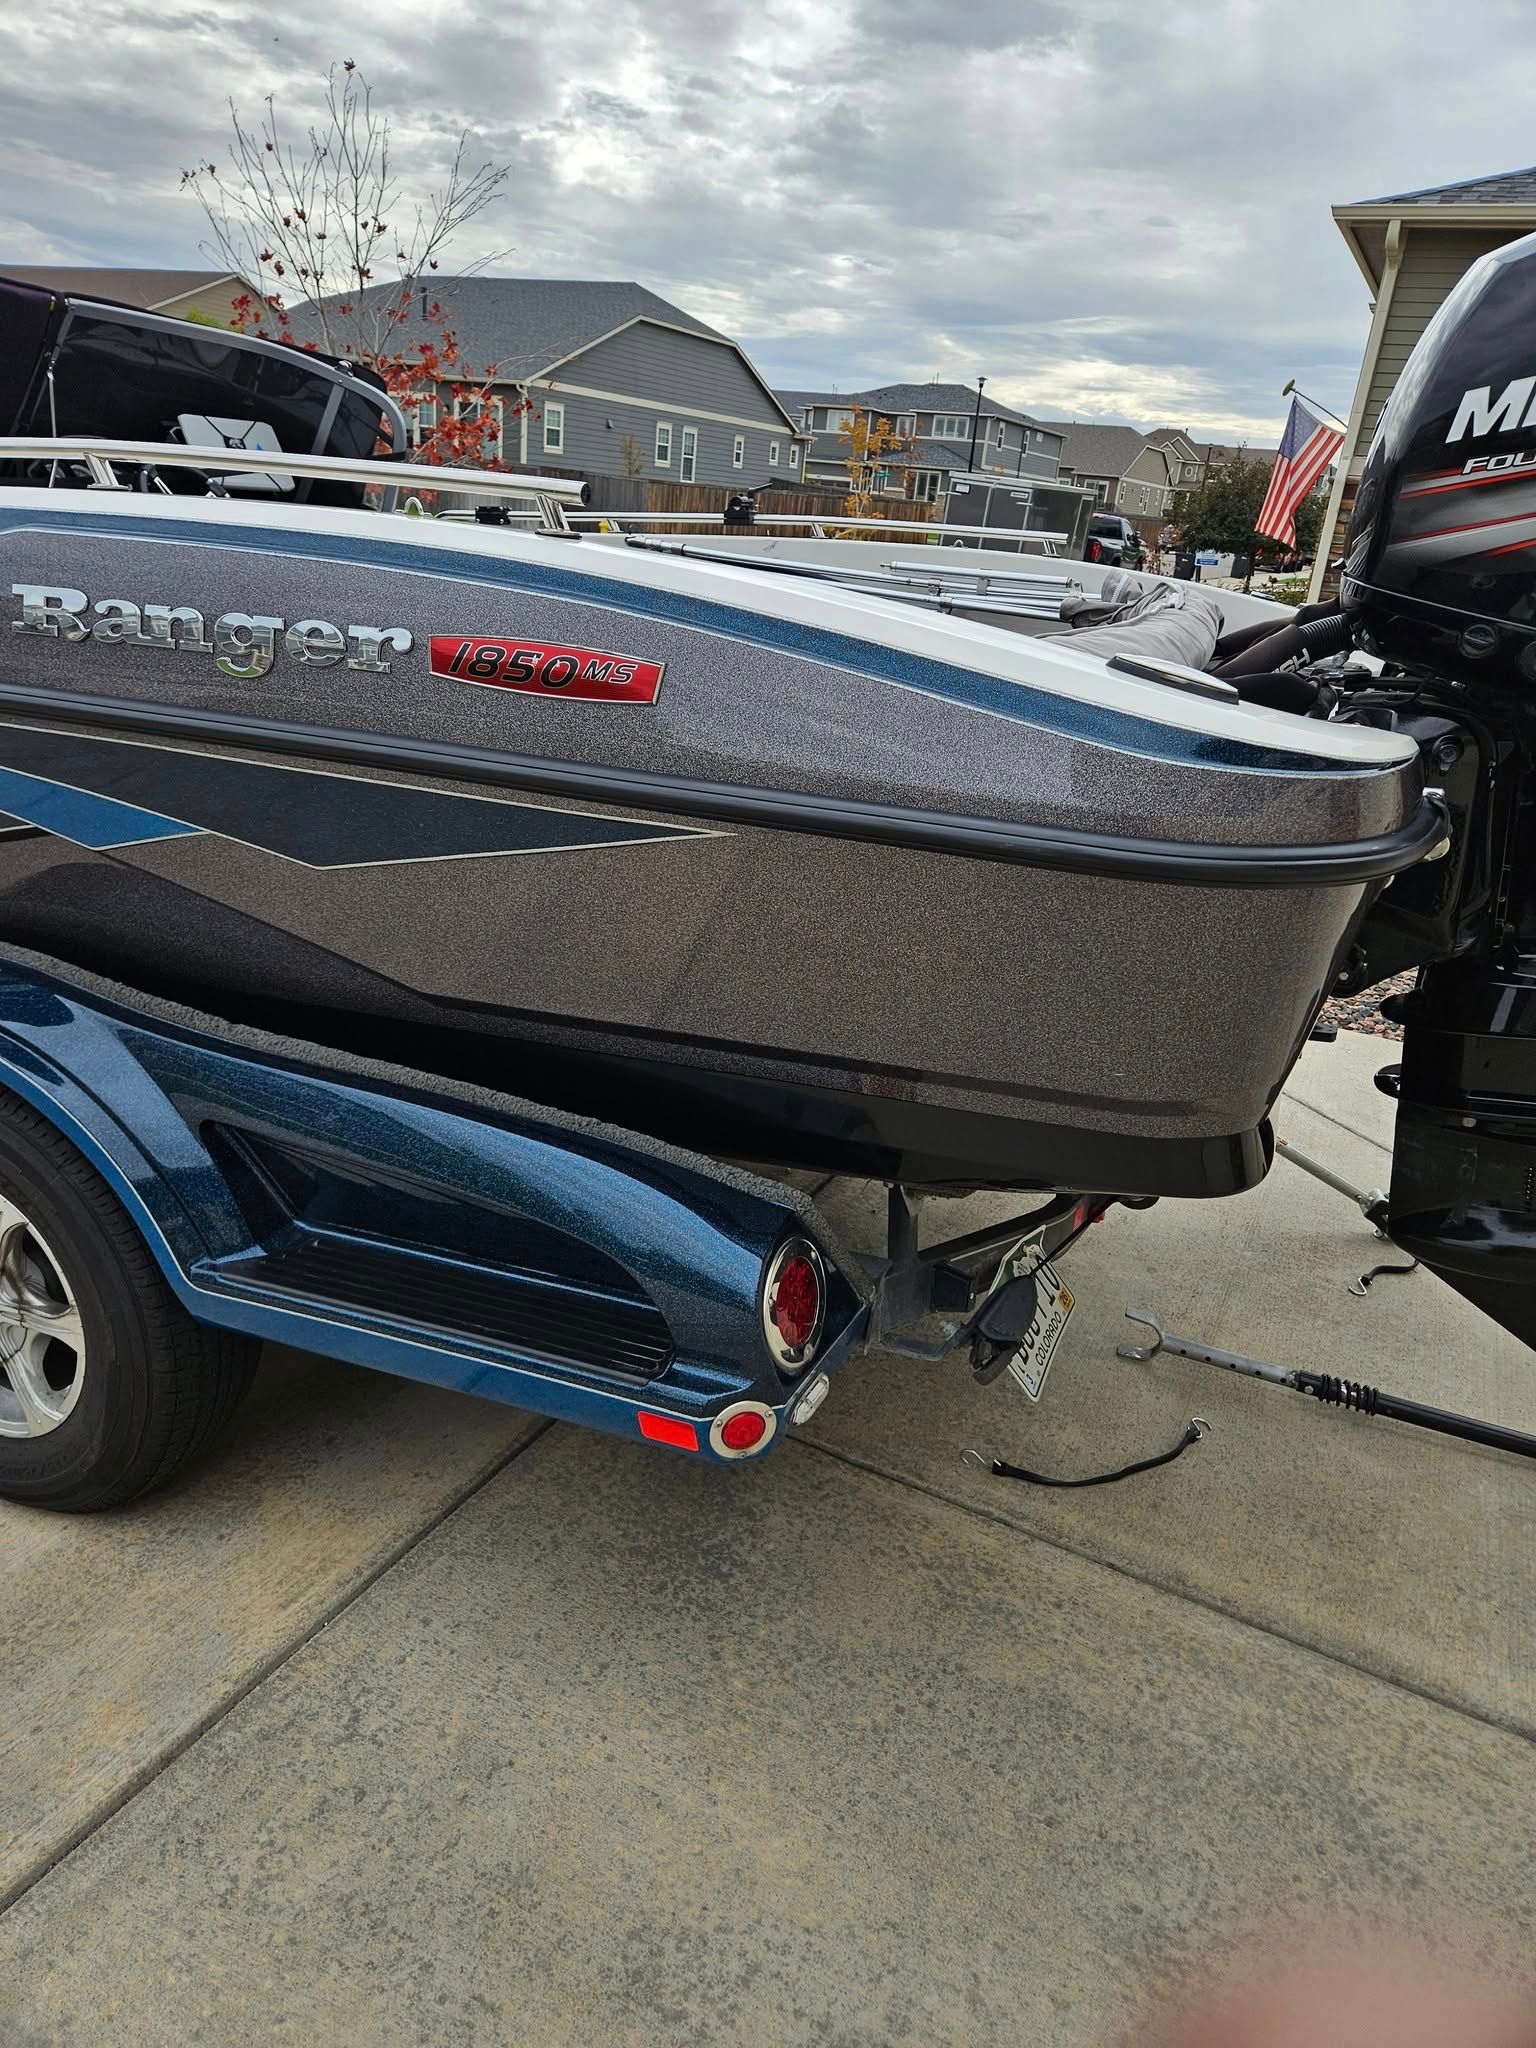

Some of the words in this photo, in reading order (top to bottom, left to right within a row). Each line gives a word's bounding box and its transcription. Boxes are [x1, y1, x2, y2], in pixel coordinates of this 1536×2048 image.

[11, 584, 415, 679] Ranger
[448, 641, 580, 689] 1850
[581, 658, 639, 685] MS
[1035, 1311, 1062, 1367] COLORADO
